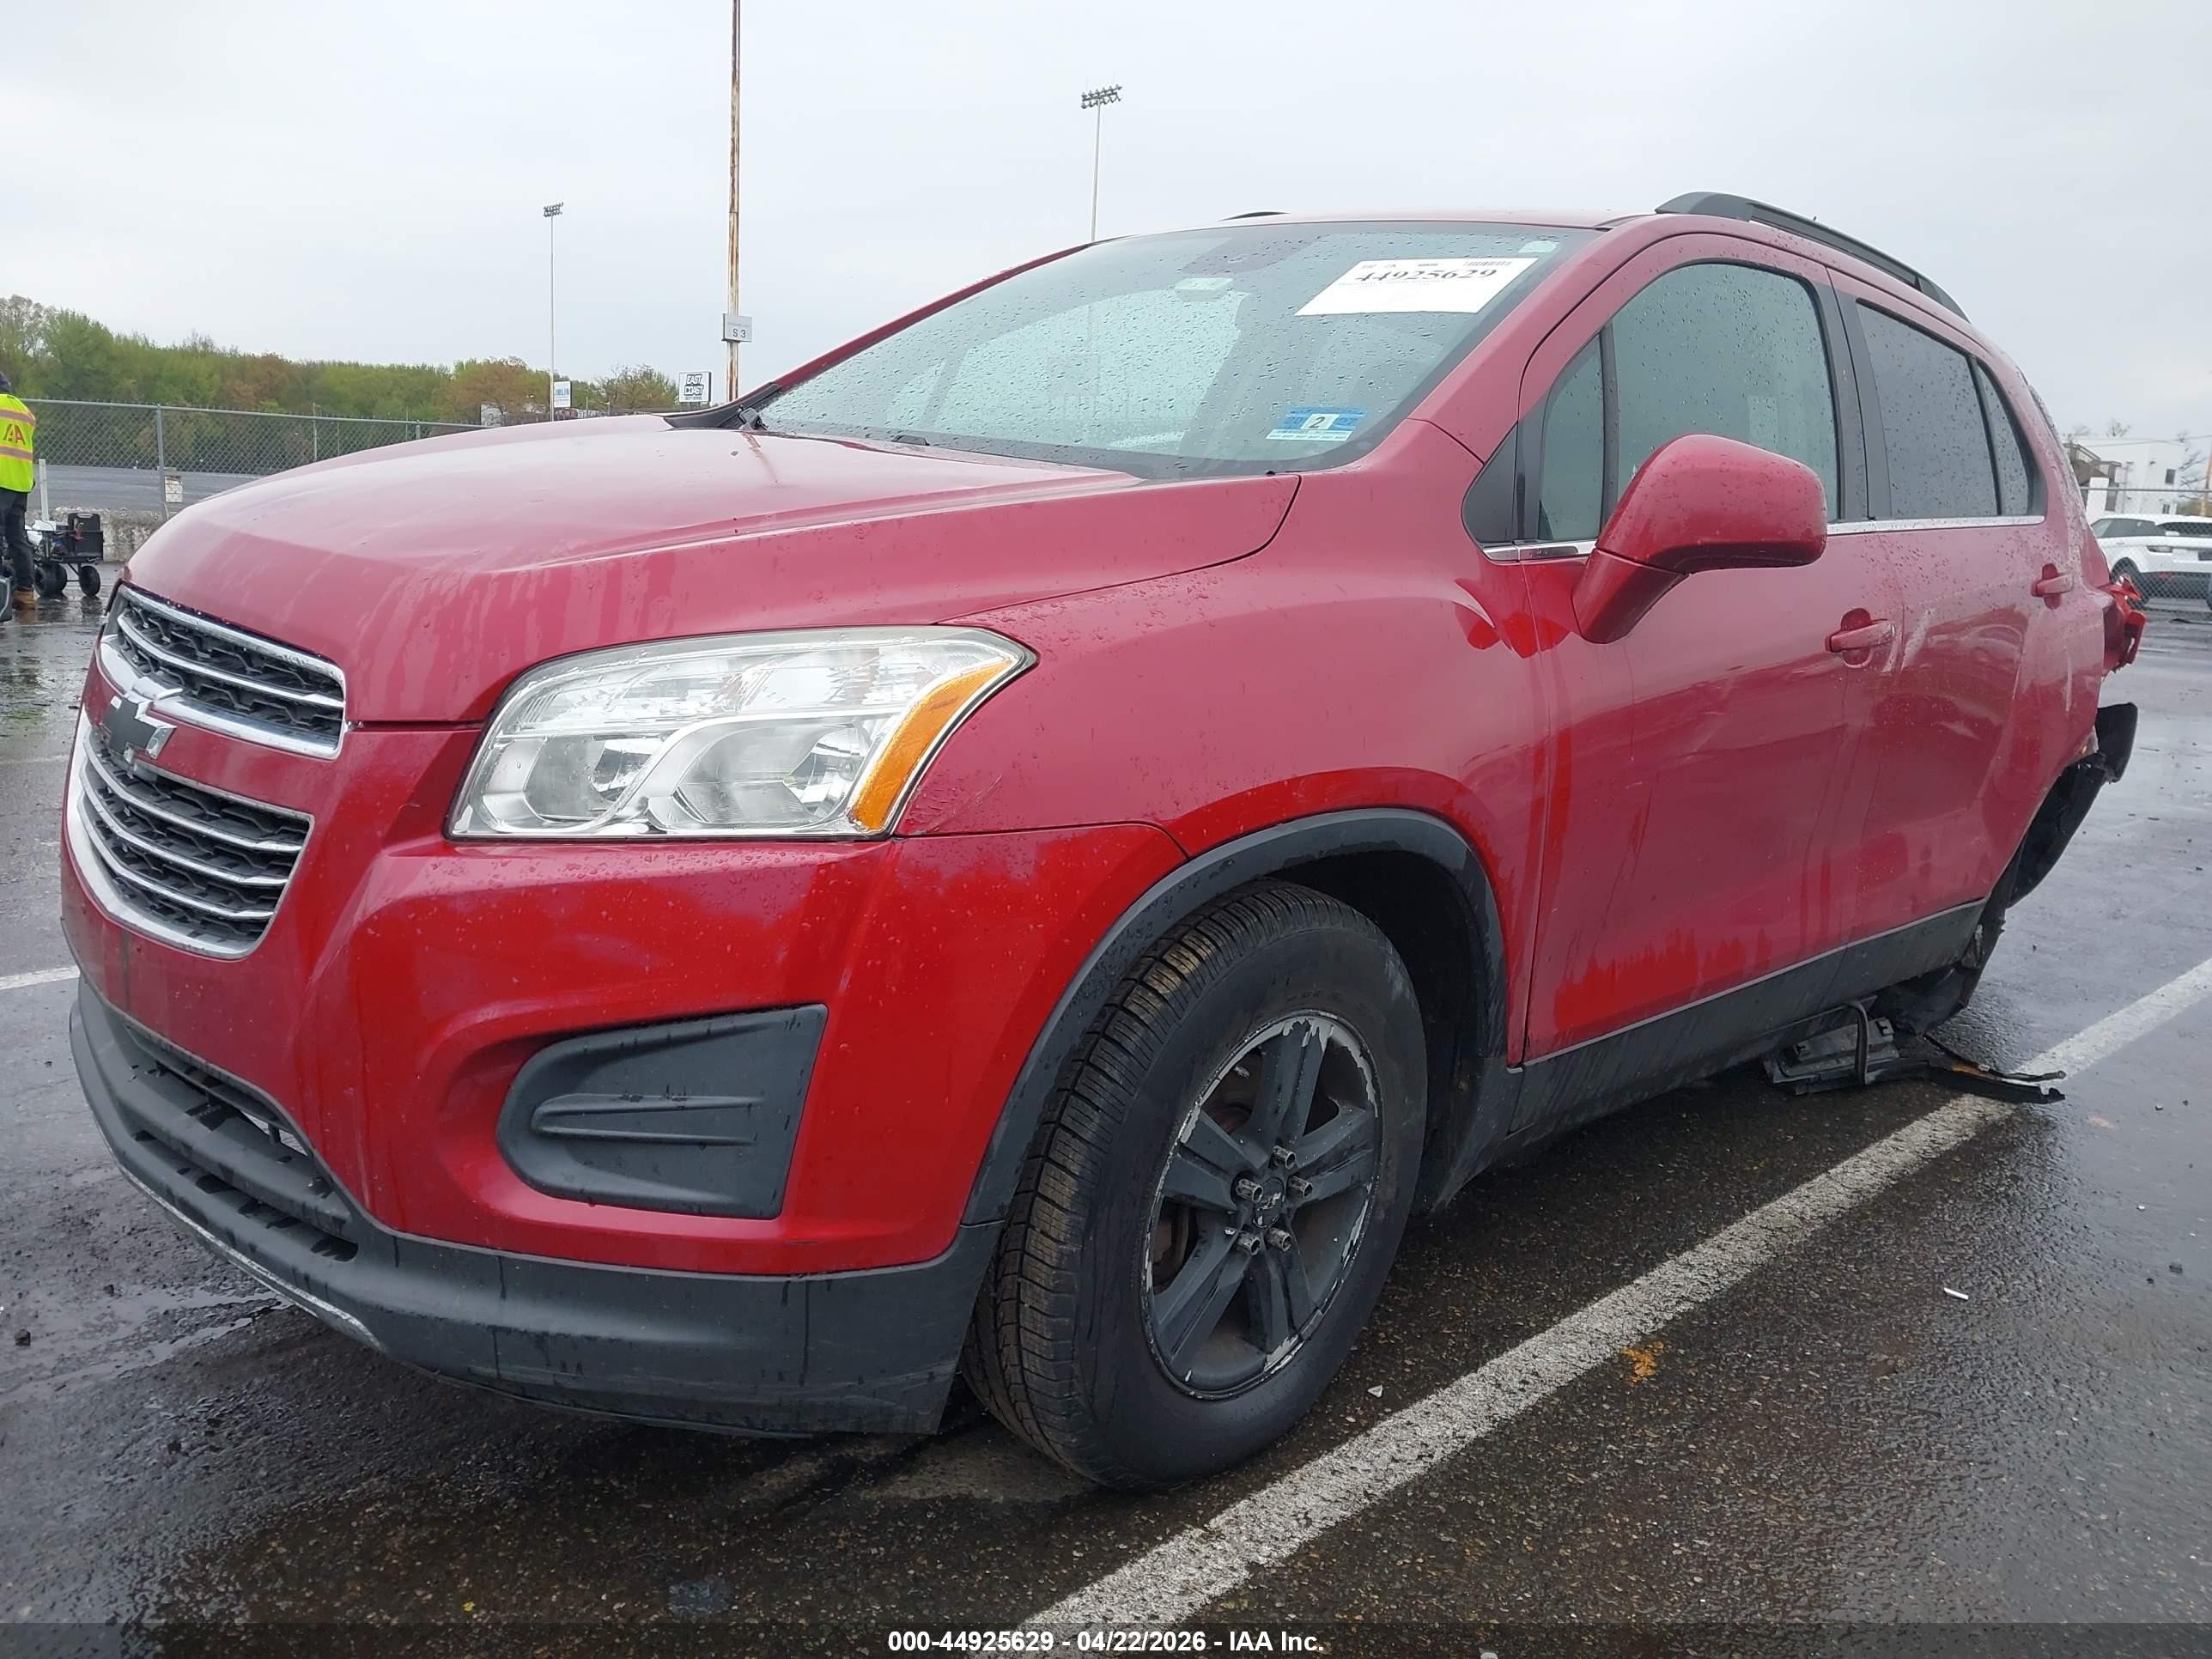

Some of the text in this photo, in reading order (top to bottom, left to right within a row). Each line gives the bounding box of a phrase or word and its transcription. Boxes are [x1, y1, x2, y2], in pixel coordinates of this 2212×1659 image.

[1355, 269, 1498, 283] 44925629
[687, 374, 702, 386] EAST
[1310, 416, 1325, 428] 2
